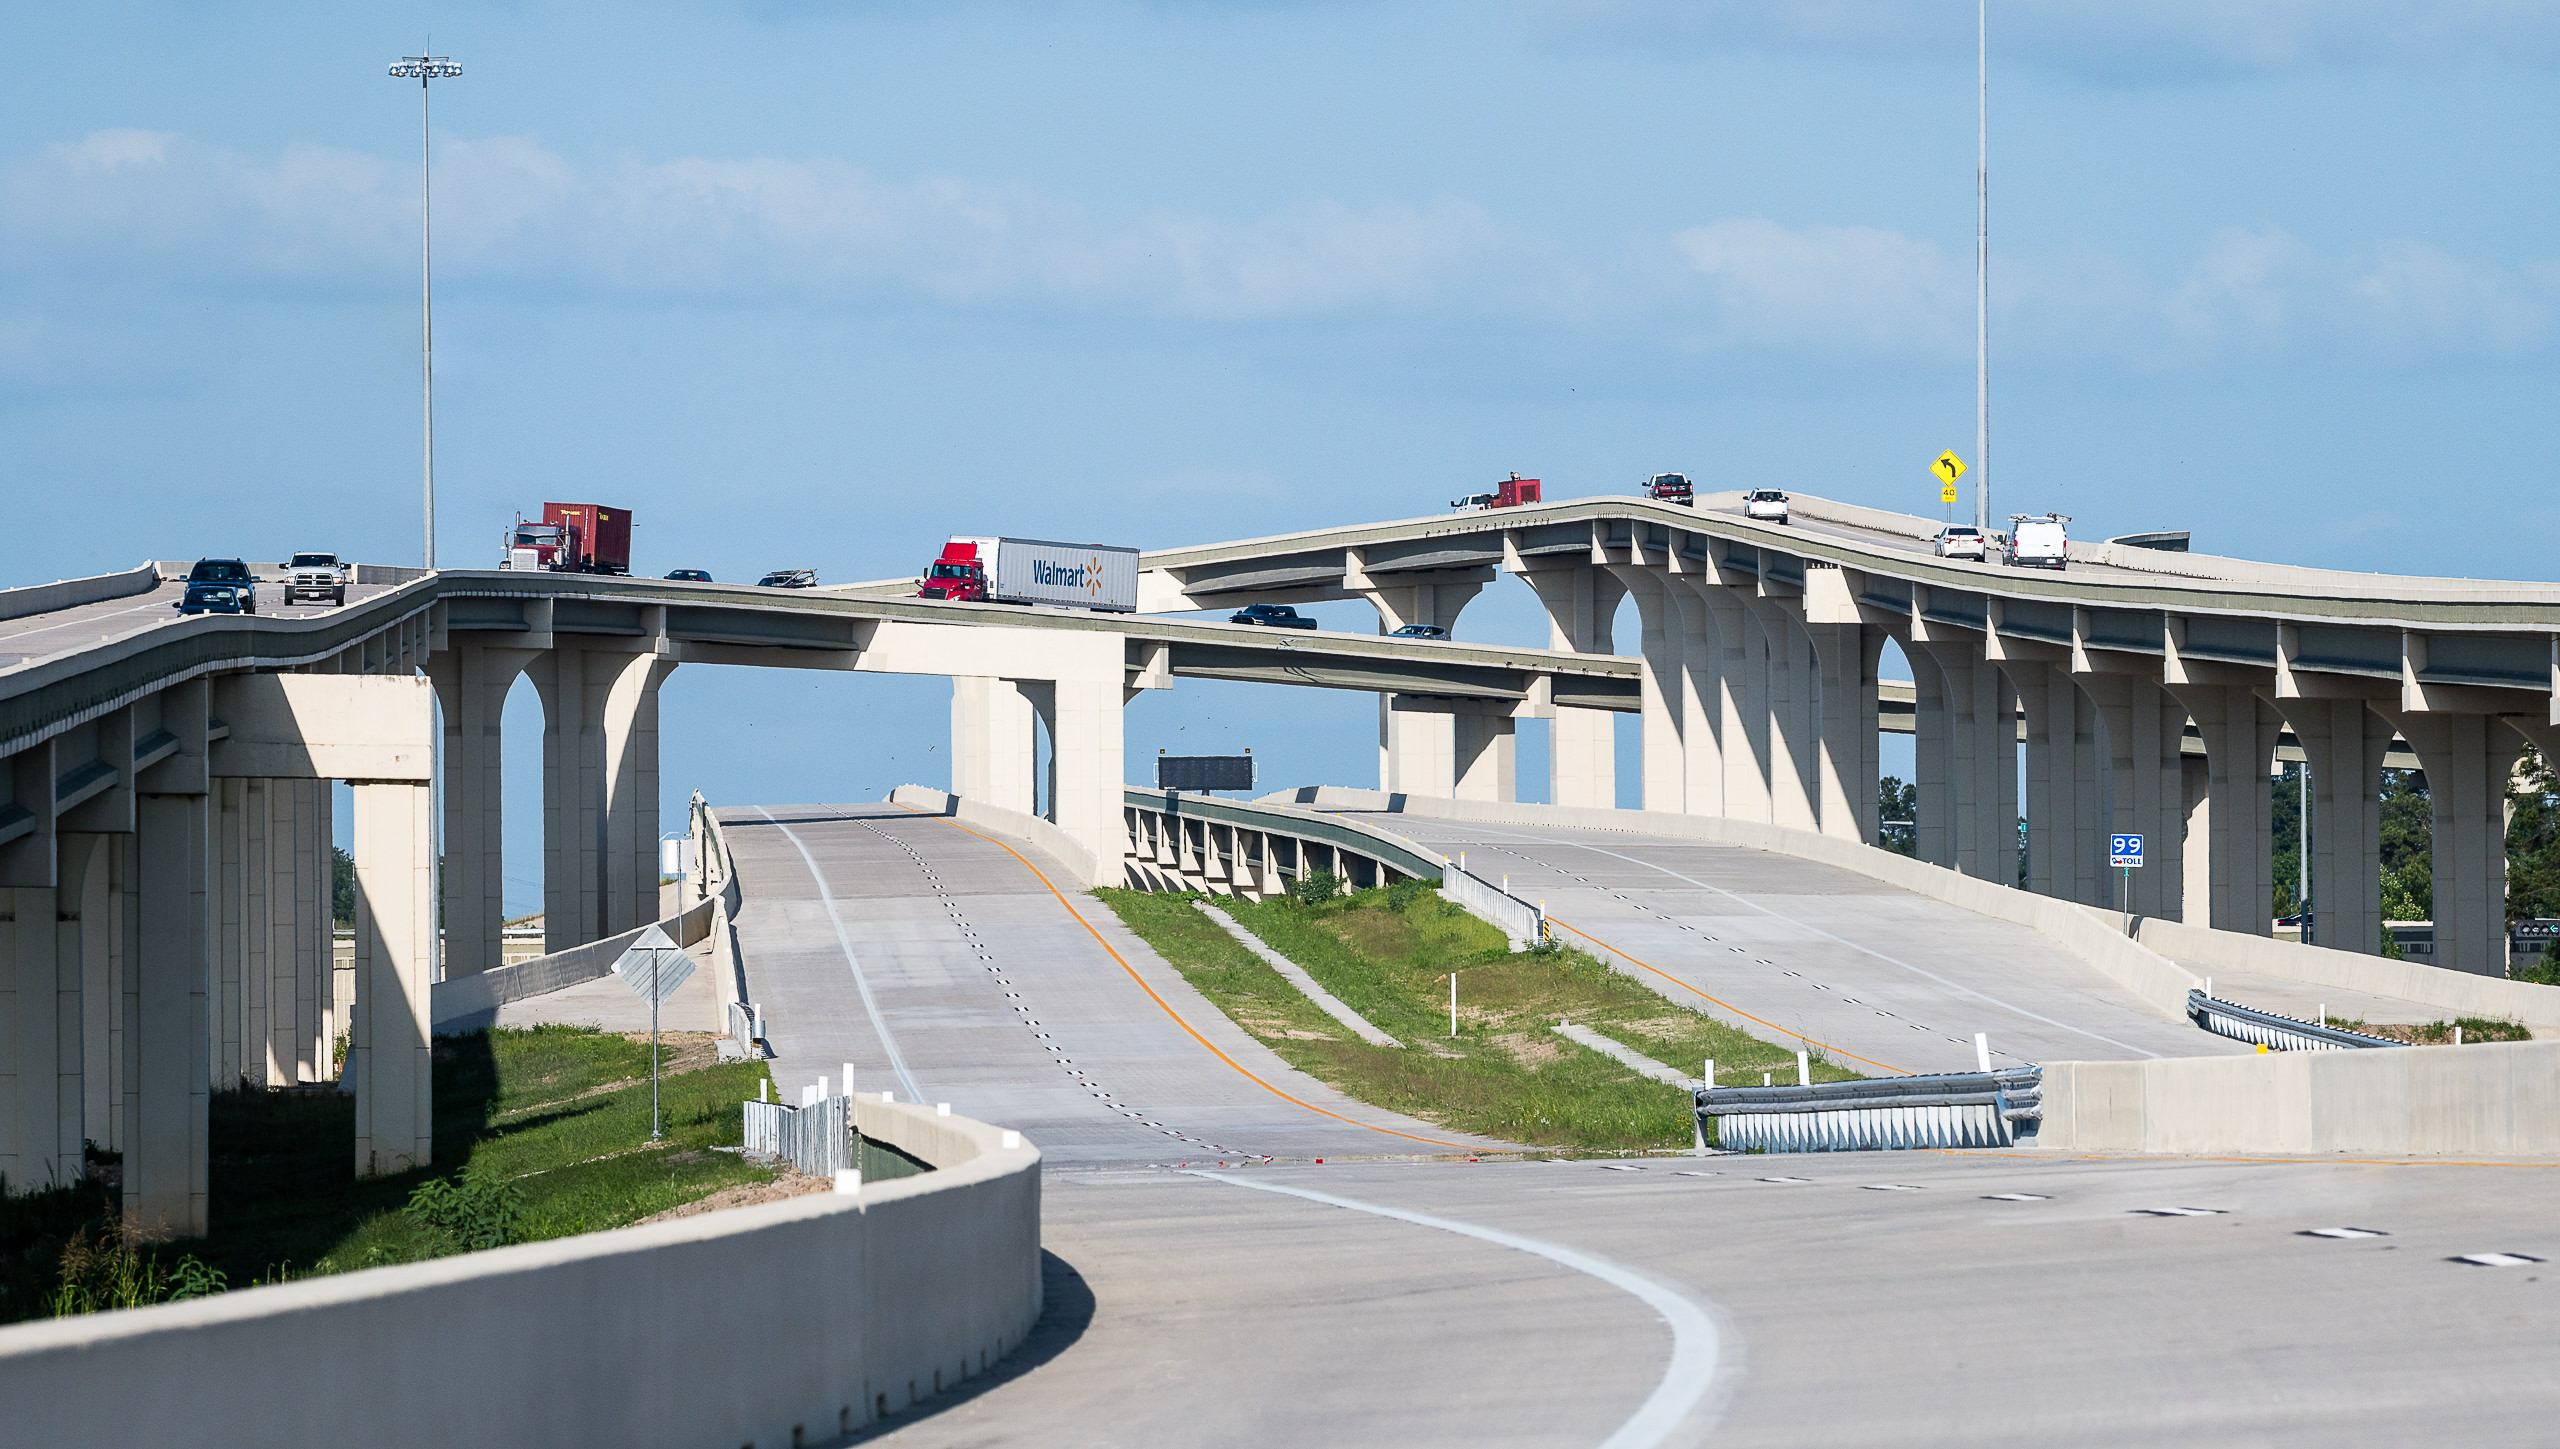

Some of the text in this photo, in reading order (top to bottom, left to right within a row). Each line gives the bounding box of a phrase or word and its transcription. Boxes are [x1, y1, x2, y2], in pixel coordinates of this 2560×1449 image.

[1033, 559, 1085, 588] Walmart
[2113, 837, 2141, 854] 99
[2122, 857, 2142, 865] TOLL
